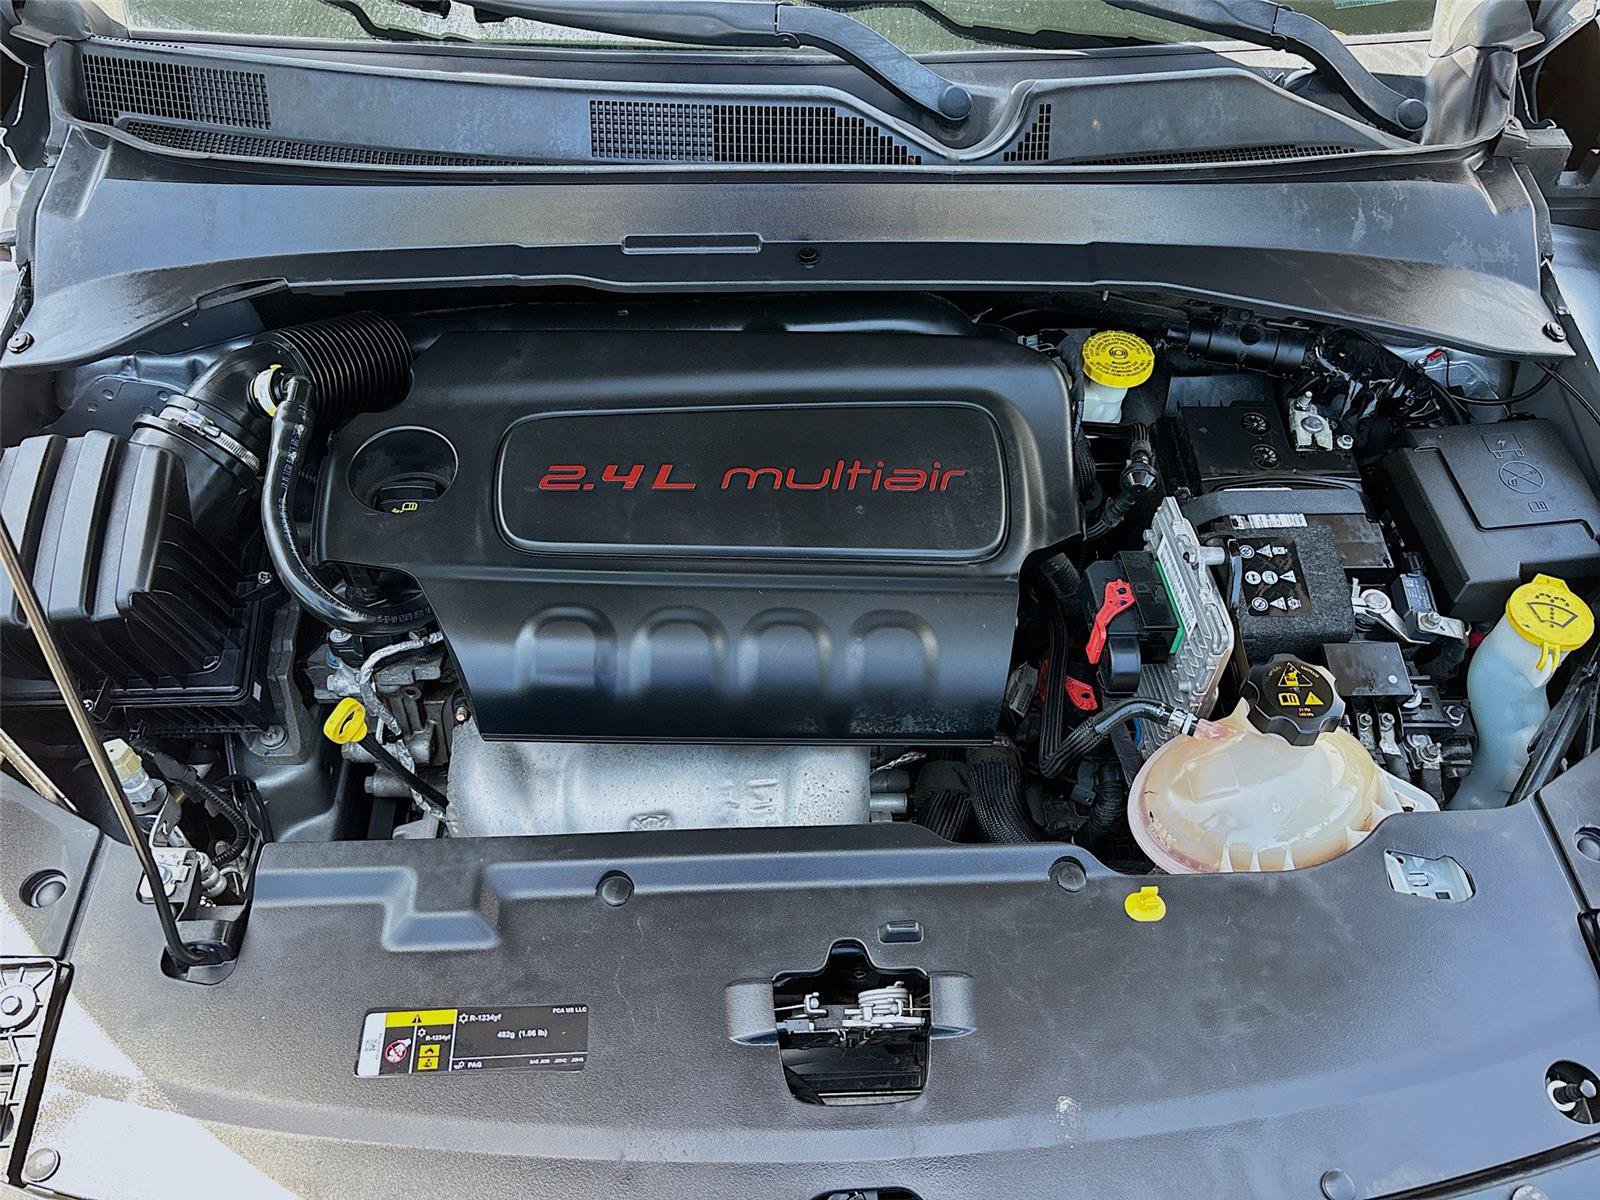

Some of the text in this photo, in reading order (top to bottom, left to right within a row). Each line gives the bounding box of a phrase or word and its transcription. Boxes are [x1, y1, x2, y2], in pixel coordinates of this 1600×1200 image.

[537, 458, 967, 491] 2.4L multiair
[469, 1013, 502, 1022] R-1234yf
[425, 1034, 451, 1042] R-1234yf
